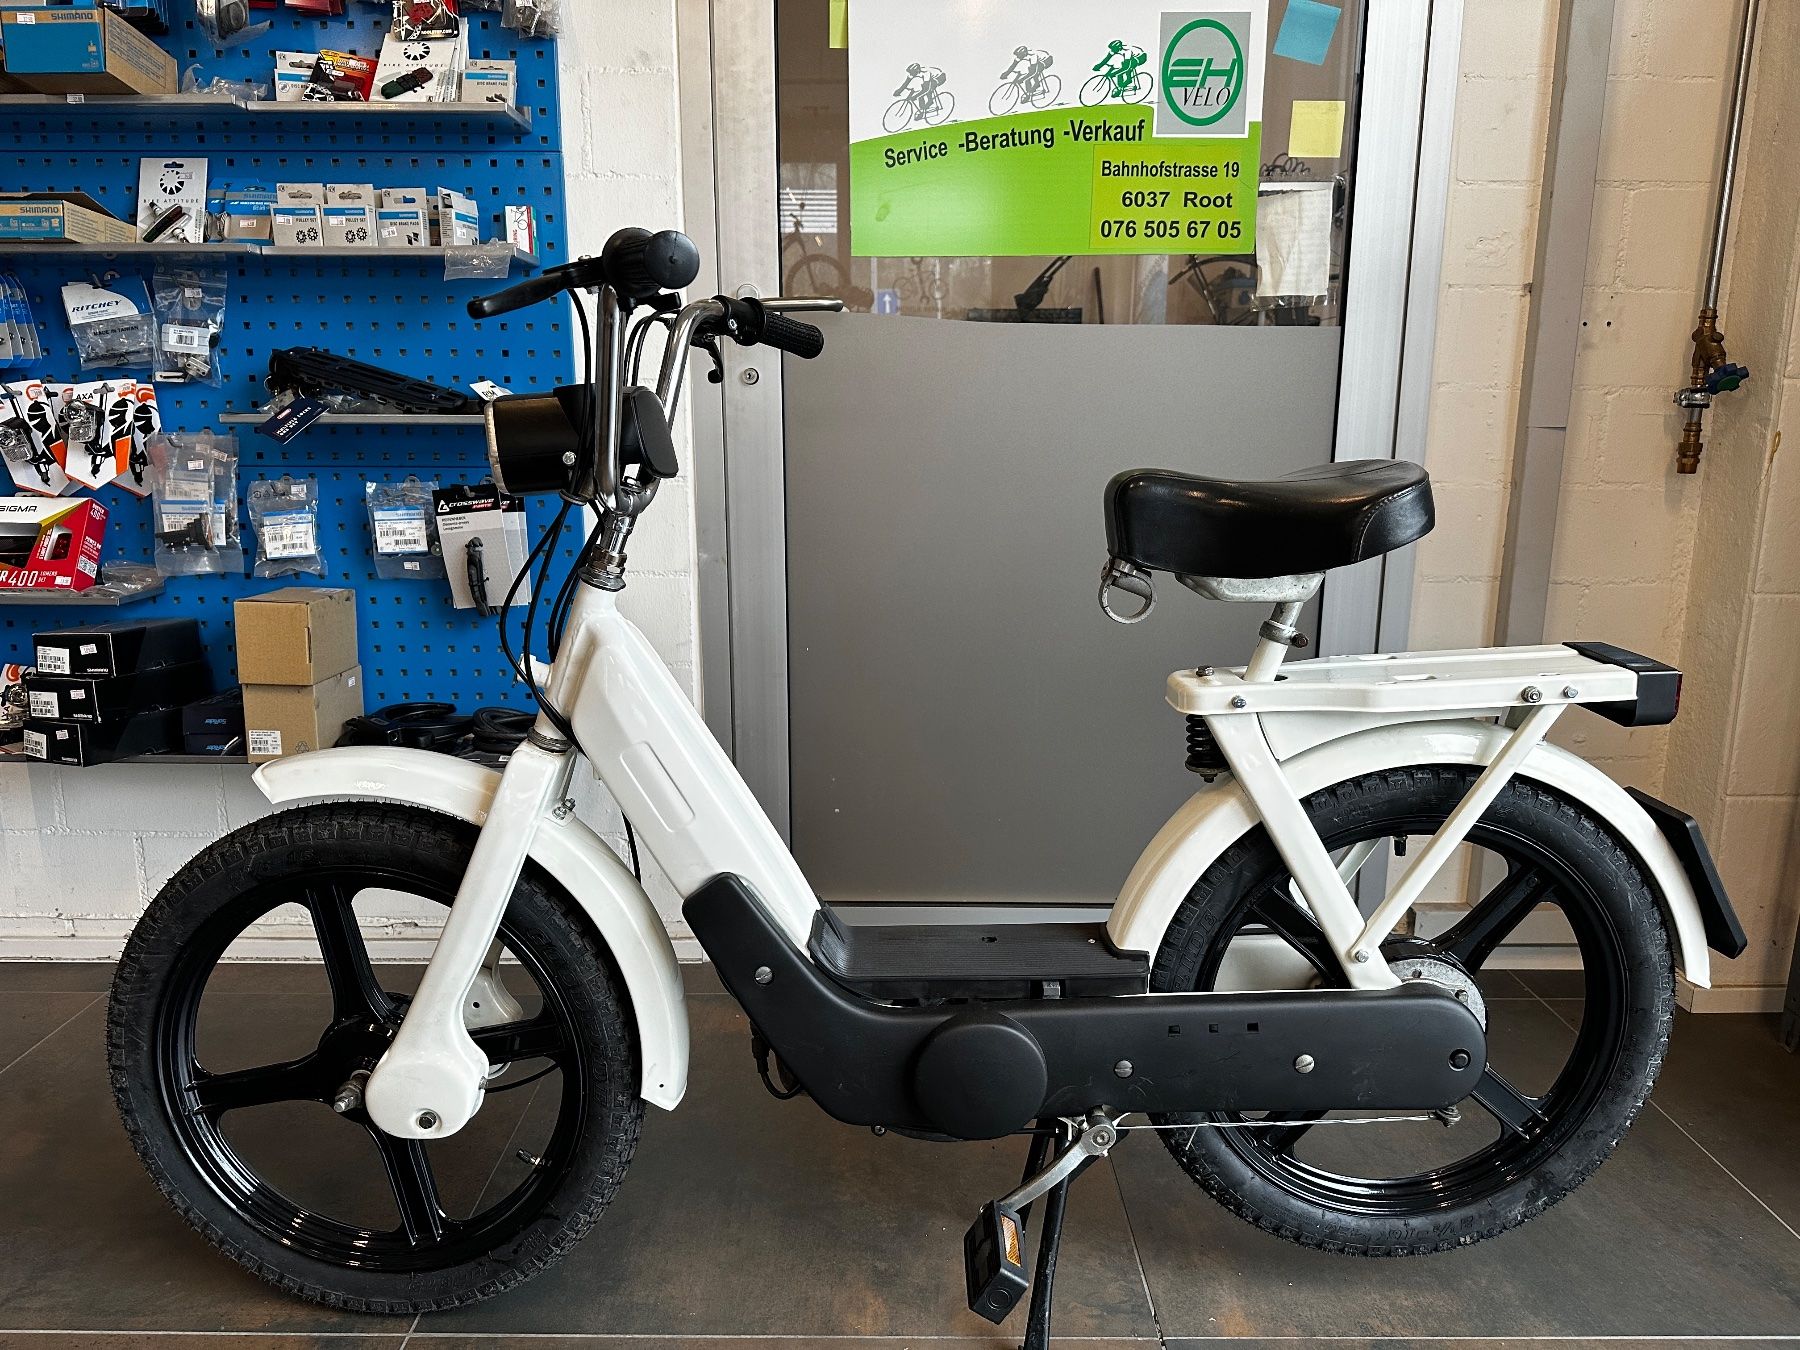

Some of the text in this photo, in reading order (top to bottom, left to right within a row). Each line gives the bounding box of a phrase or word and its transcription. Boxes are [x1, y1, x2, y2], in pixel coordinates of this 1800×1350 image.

[51, 12, 93, 20] SHIMANO
[1168, 58, 1237, 88] EH
[1183, 87, 1231, 107] VELO
[884, 119, 1146, 168] Service -Beratung -Verkauf
[1101, 160, 1218, 178] Bahnhofstrasse
[1224, 161, 1240, 178] 19
[1122, 191, 1233, 208] 6037 Root
[20, 206, 59, 214] SHIMANO
[1101, 220, 1241, 239] 076 505 67 05
[71, 299, 122, 313] RITCHEY
[118, 325, 139, 333] TAIWAN
[90, 508, 101, 520] 400
[8, 570, 39, 586] 400
